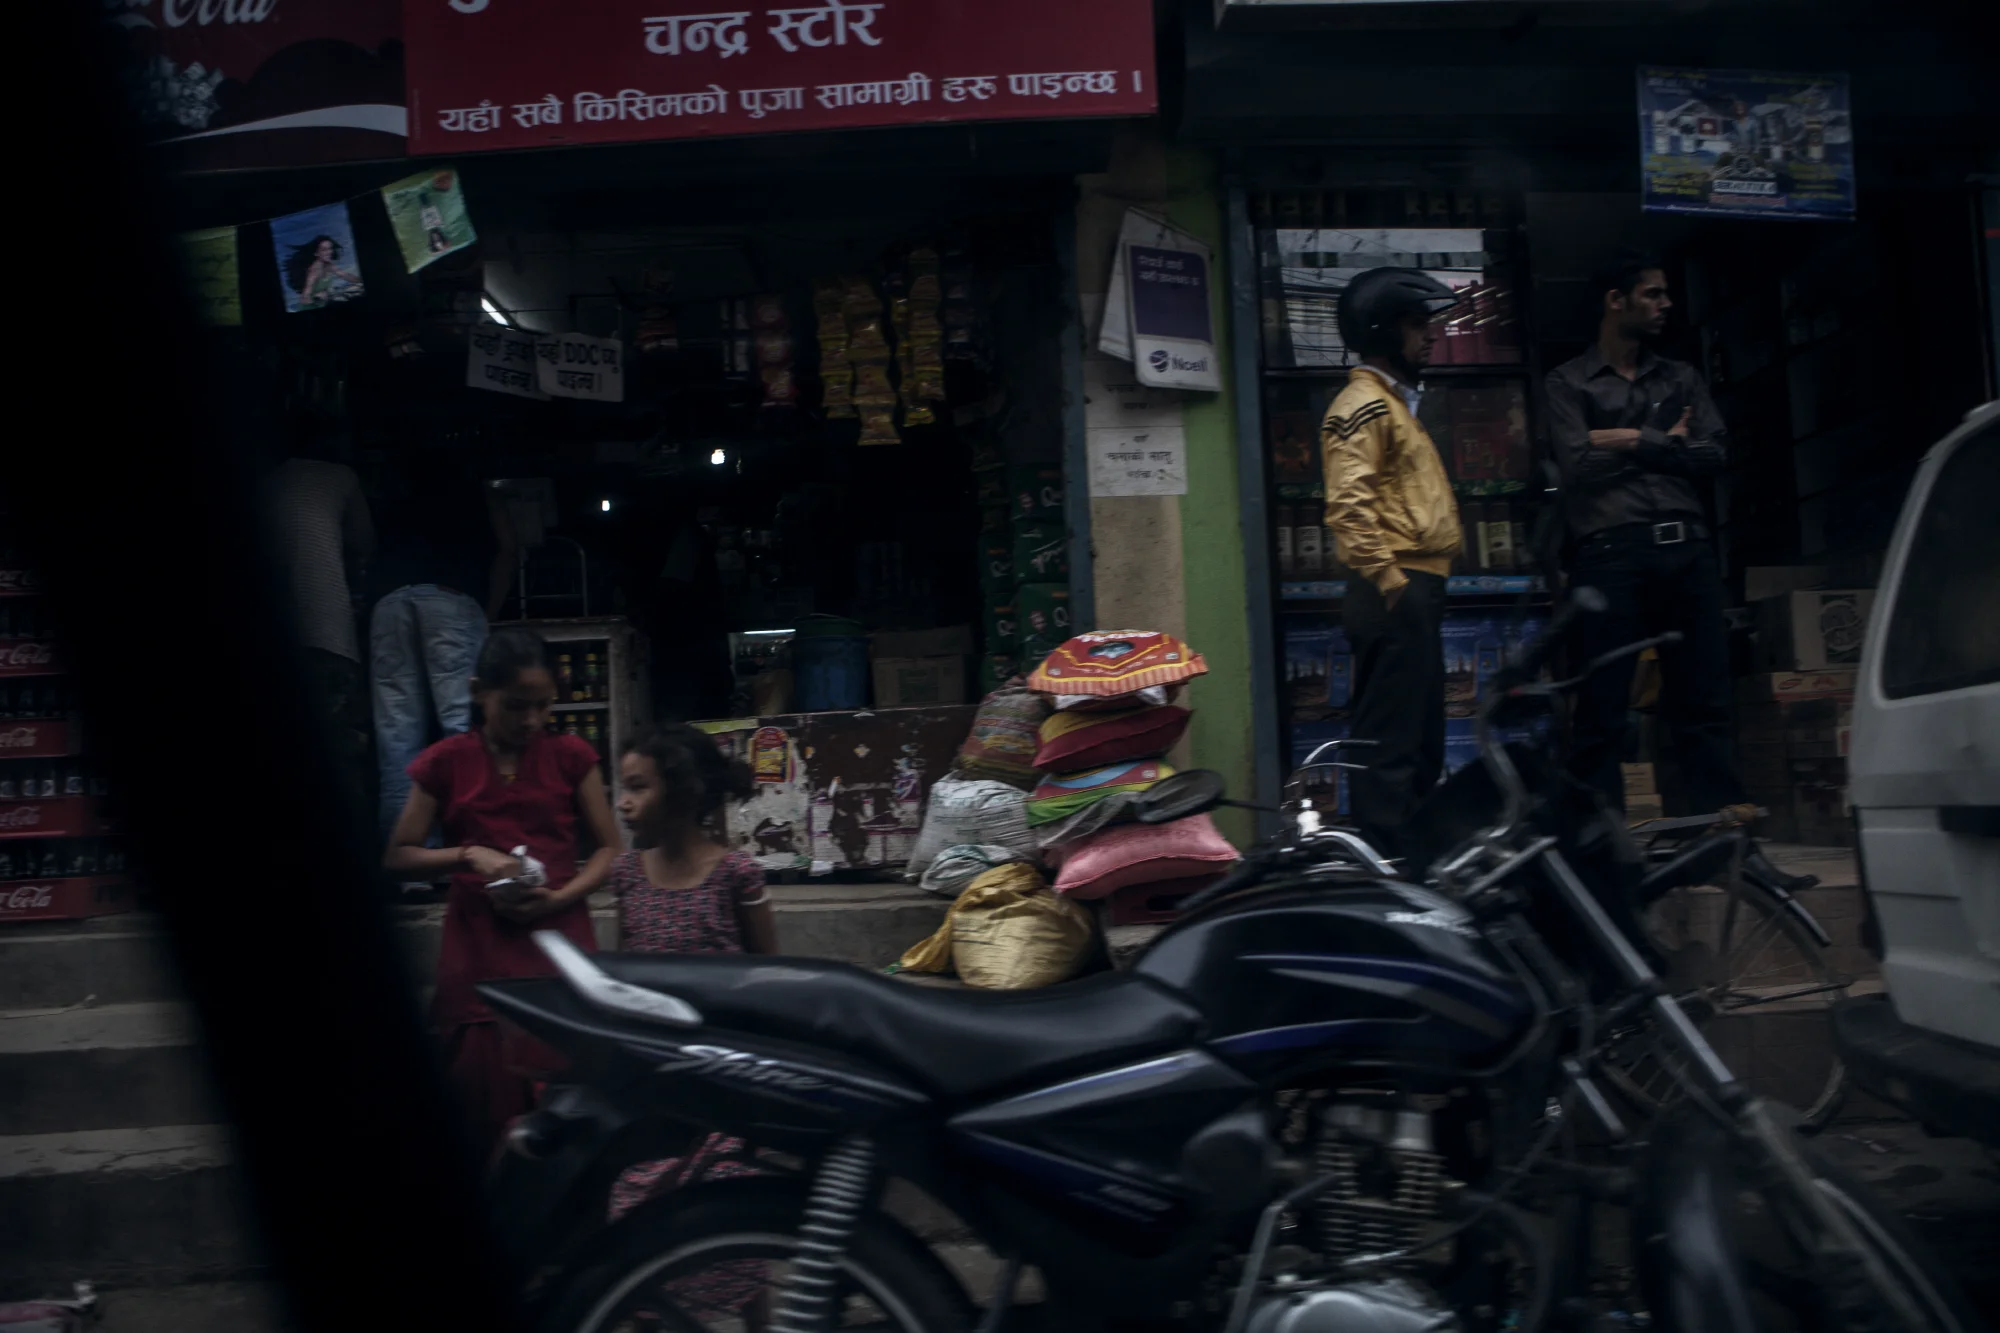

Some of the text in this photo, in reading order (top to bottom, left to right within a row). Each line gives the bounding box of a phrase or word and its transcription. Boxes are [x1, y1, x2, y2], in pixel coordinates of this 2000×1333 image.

[641, 0, 885, 58] चन्द्र स्टोर
[438, 99, 503, 132] यहाँ
[511, 94, 564, 128] सबै
[573, 84, 729, 122] किसिमको
[738, 86, 805, 119] पुजा
[815, 72, 932, 110] सामाग्री
[1008, 70, 1118, 97] पाइन्छ
